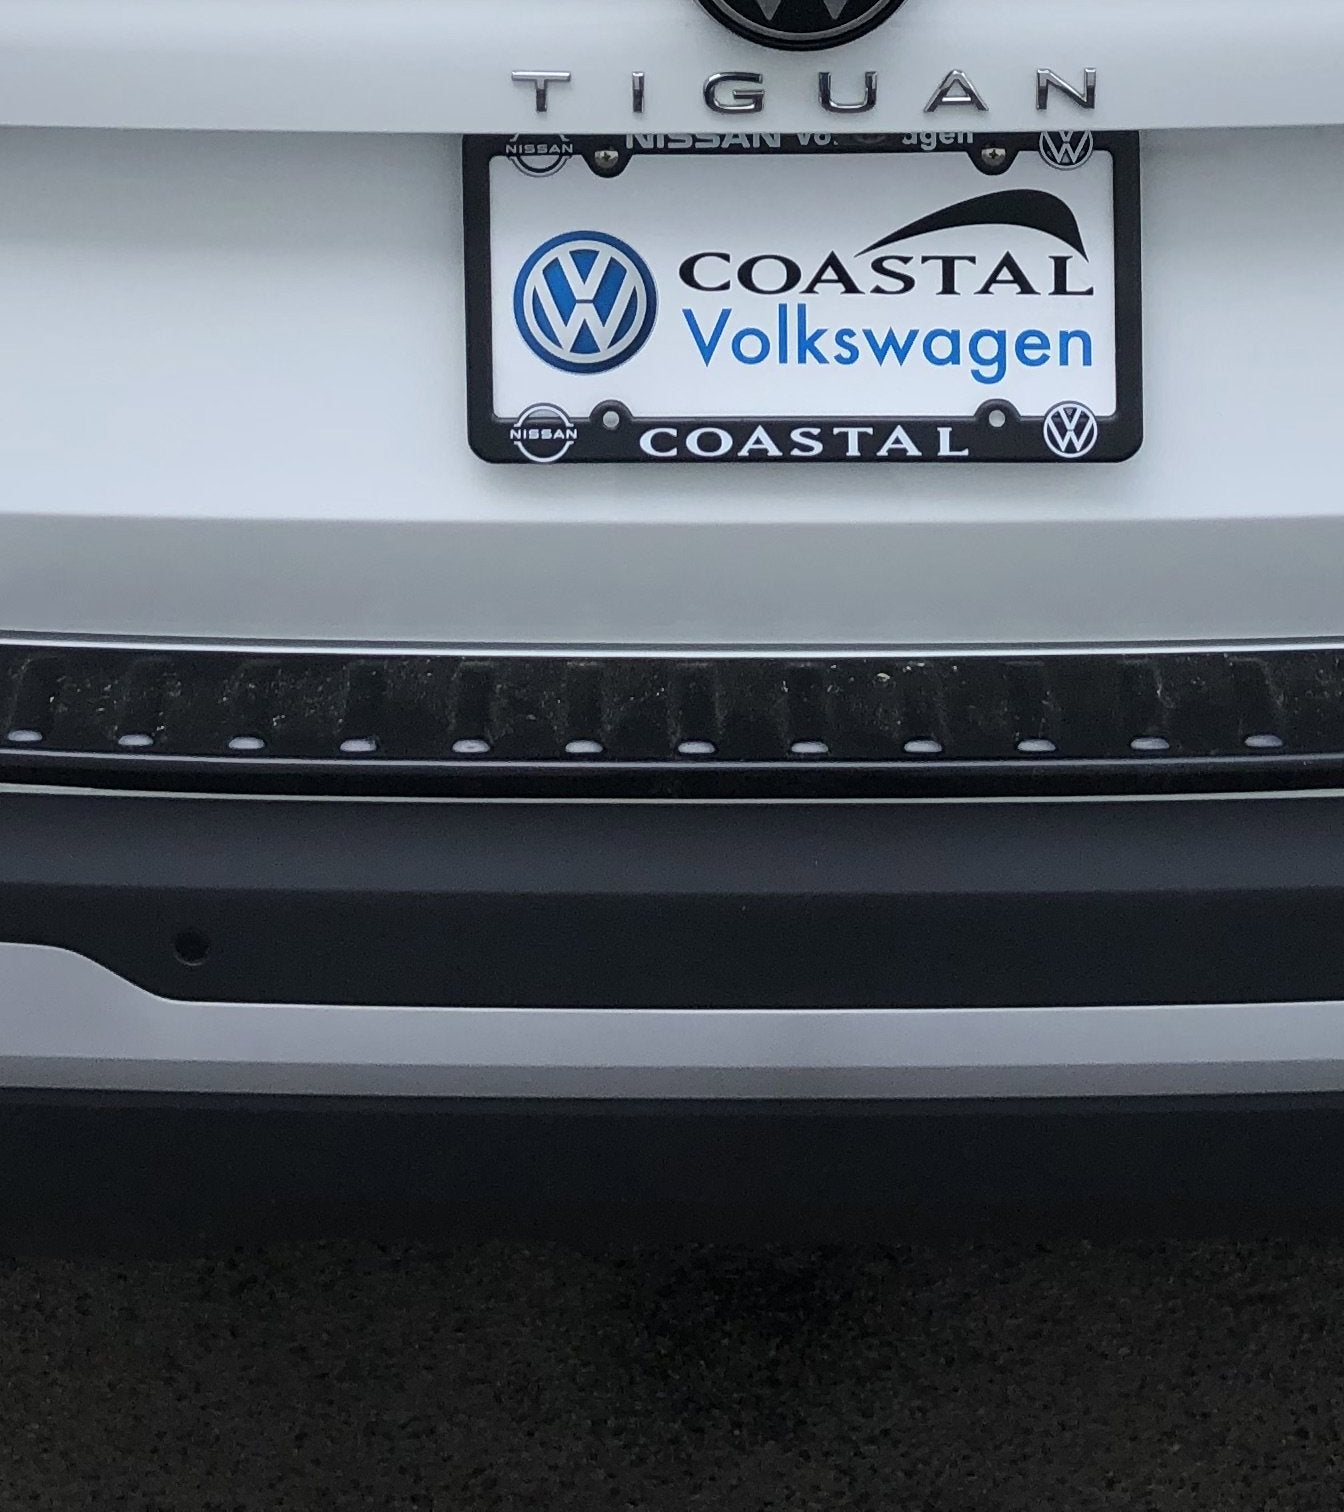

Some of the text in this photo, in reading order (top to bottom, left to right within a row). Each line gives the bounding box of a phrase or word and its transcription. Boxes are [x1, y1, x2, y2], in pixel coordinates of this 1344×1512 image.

[511, 67, 1097, 114] TIGUAN
[504, 142, 574, 154] NISSAN
[678, 250, 1095, 296] COASTAL
[681, 303, 1093, 384] Volkswagen
[509, 428, 578, 441] NISSAN
[639, 425, 969, 458] COASTAL
